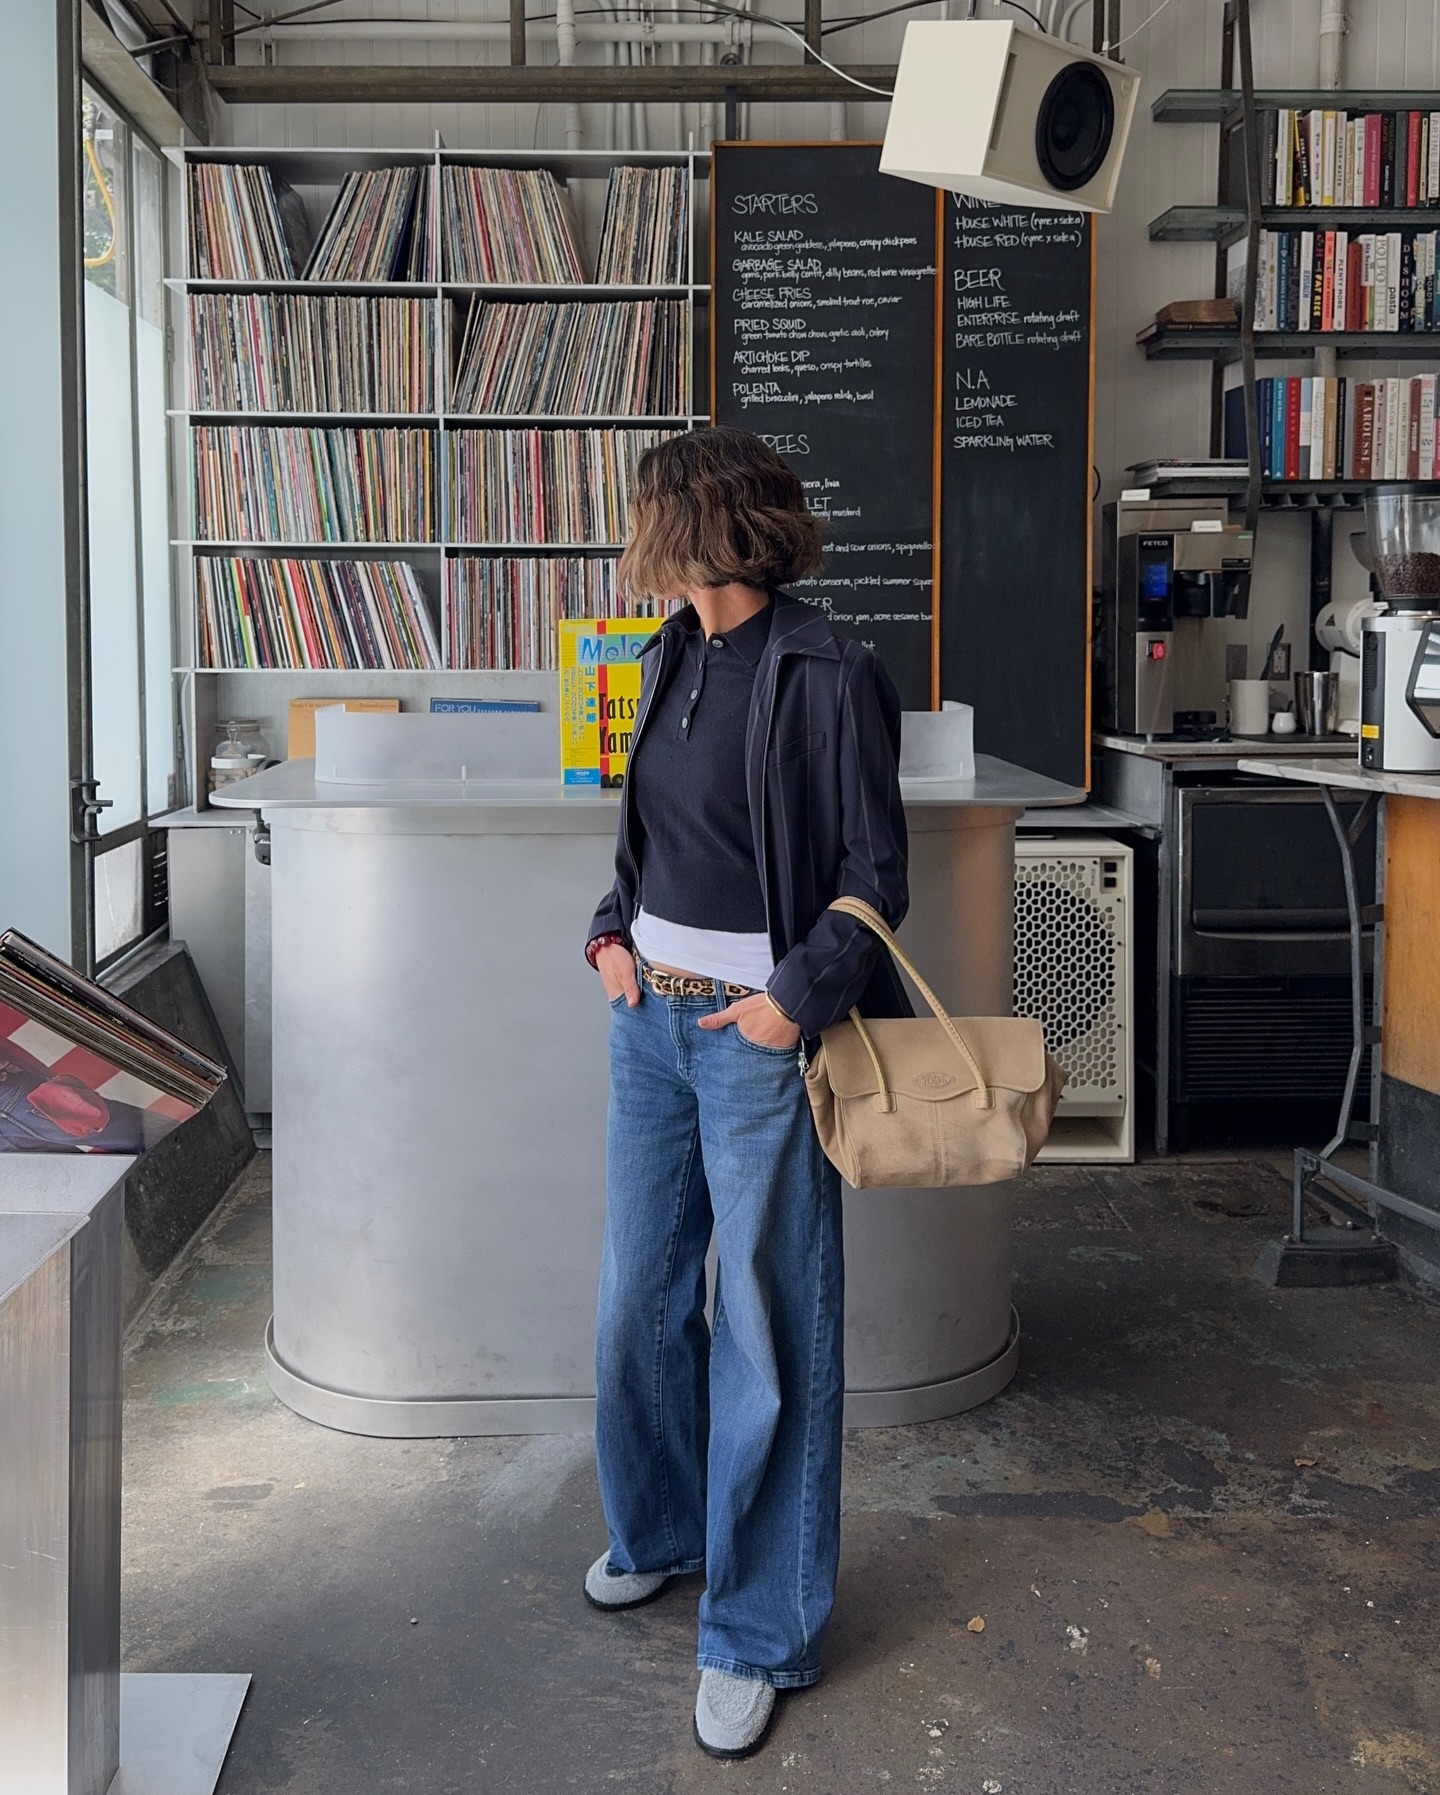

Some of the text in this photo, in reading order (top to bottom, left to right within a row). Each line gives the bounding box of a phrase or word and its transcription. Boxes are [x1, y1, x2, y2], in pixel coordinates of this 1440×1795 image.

[1430, 113, 1439, 196] TARTINE BREAD
[731, 193, 818, 215] STARTERS
[955, 215, 991, 230] HOUSE
[992, 214, 1029, 229] WHITE
[733, 229, 804, 243] KALE SALAD
[954, 234, 994, 249] HOUSE
[993, 233, 1020, 247] RED
[741, 240, 773, 251] avocado
[773, 242, 795, 256] green
[859, 239, 882, 252] crispy
[732, 258, 822, 272] GARBAGE SALAD
[1376, 239, 1386, 283] POLPO
[763, 270, 782, 283] pork
[782, 270, 800, 284] belly
[825, 267, 842, 282] dilly
[842, 266, 867, 279] beans,
[867, 266, 880, 278] red
[881, 268, 898, 277] wine
[953, 268, 1006, 292] BEER
[1314, 274, 1323, 293] FAT
[1400, 244, 1411, 320] DISHOOM
[1426, 248, 1434, 303] CROSSROADS
[732, 286, 813, 301] CHEESE FRIES
[1388, 287, 1397, 314] pasta
[741, 298, 788, 310] caramelized
[789, 300, 816, 310] onions,
[816, 296, 842, 307] smoked
[842, 295, 862, 307] trout
[877, 295, 903, 305] caviar
[957, 295, 1012, 310] HIGH LIFE
[1313, 295, 1321, 317] RICE
[733, 318, 807, 335] FRIED SQUID
[956, 309, 1081, 331] ENTERPRISE rotating draft
[741, 331, 763, 346] green
[763, 329, 788, 341] tomato
[788, 329, 807, 339] chow
[828, 328, 851, 343] garlic
[869, 326, 890, 341] celery
[955, 330, 1082, 351] BARE BOTTLE rotating draft
[733, 349, 811, 364] ARTICHOKE DIP
[741, 364, 771, 375] charred
[819, 361, 843, 374] crispy
[843, 357, 872, 369] tortillas
[732, 381, 782, 397] POLENTA
[740, 393, 765, 409] grilled
[856, 388, 875, 401] basil
[955, 394, 1019, 411] LEMONADE
[956, 413, 1004, 429] ICED TEA
[1361, 396, 1373, 464] LAROUSSE
[756, 433, 810, 455] REES
[1015, 434, 1056, 449] WATER
[804, 496, 832, 511] LET
[810, 506, 861, 521] honey mustard
[821, 541, 835, 552] eet
[835, 542, 849, 553] and
[849, 543, 867, 552] sour
[895, 541, 933, 557] spigarello
[853, 575, 881, 591] pickled
[881, 578, 911, 587] summer
[833, 613, 854, 622] onion
[892, 612, 920, 622] sesame
[435, 703, 455, 713] FOR
[456, 704, 477, 714] YOU
[599, 693, 640, 720] Tats
